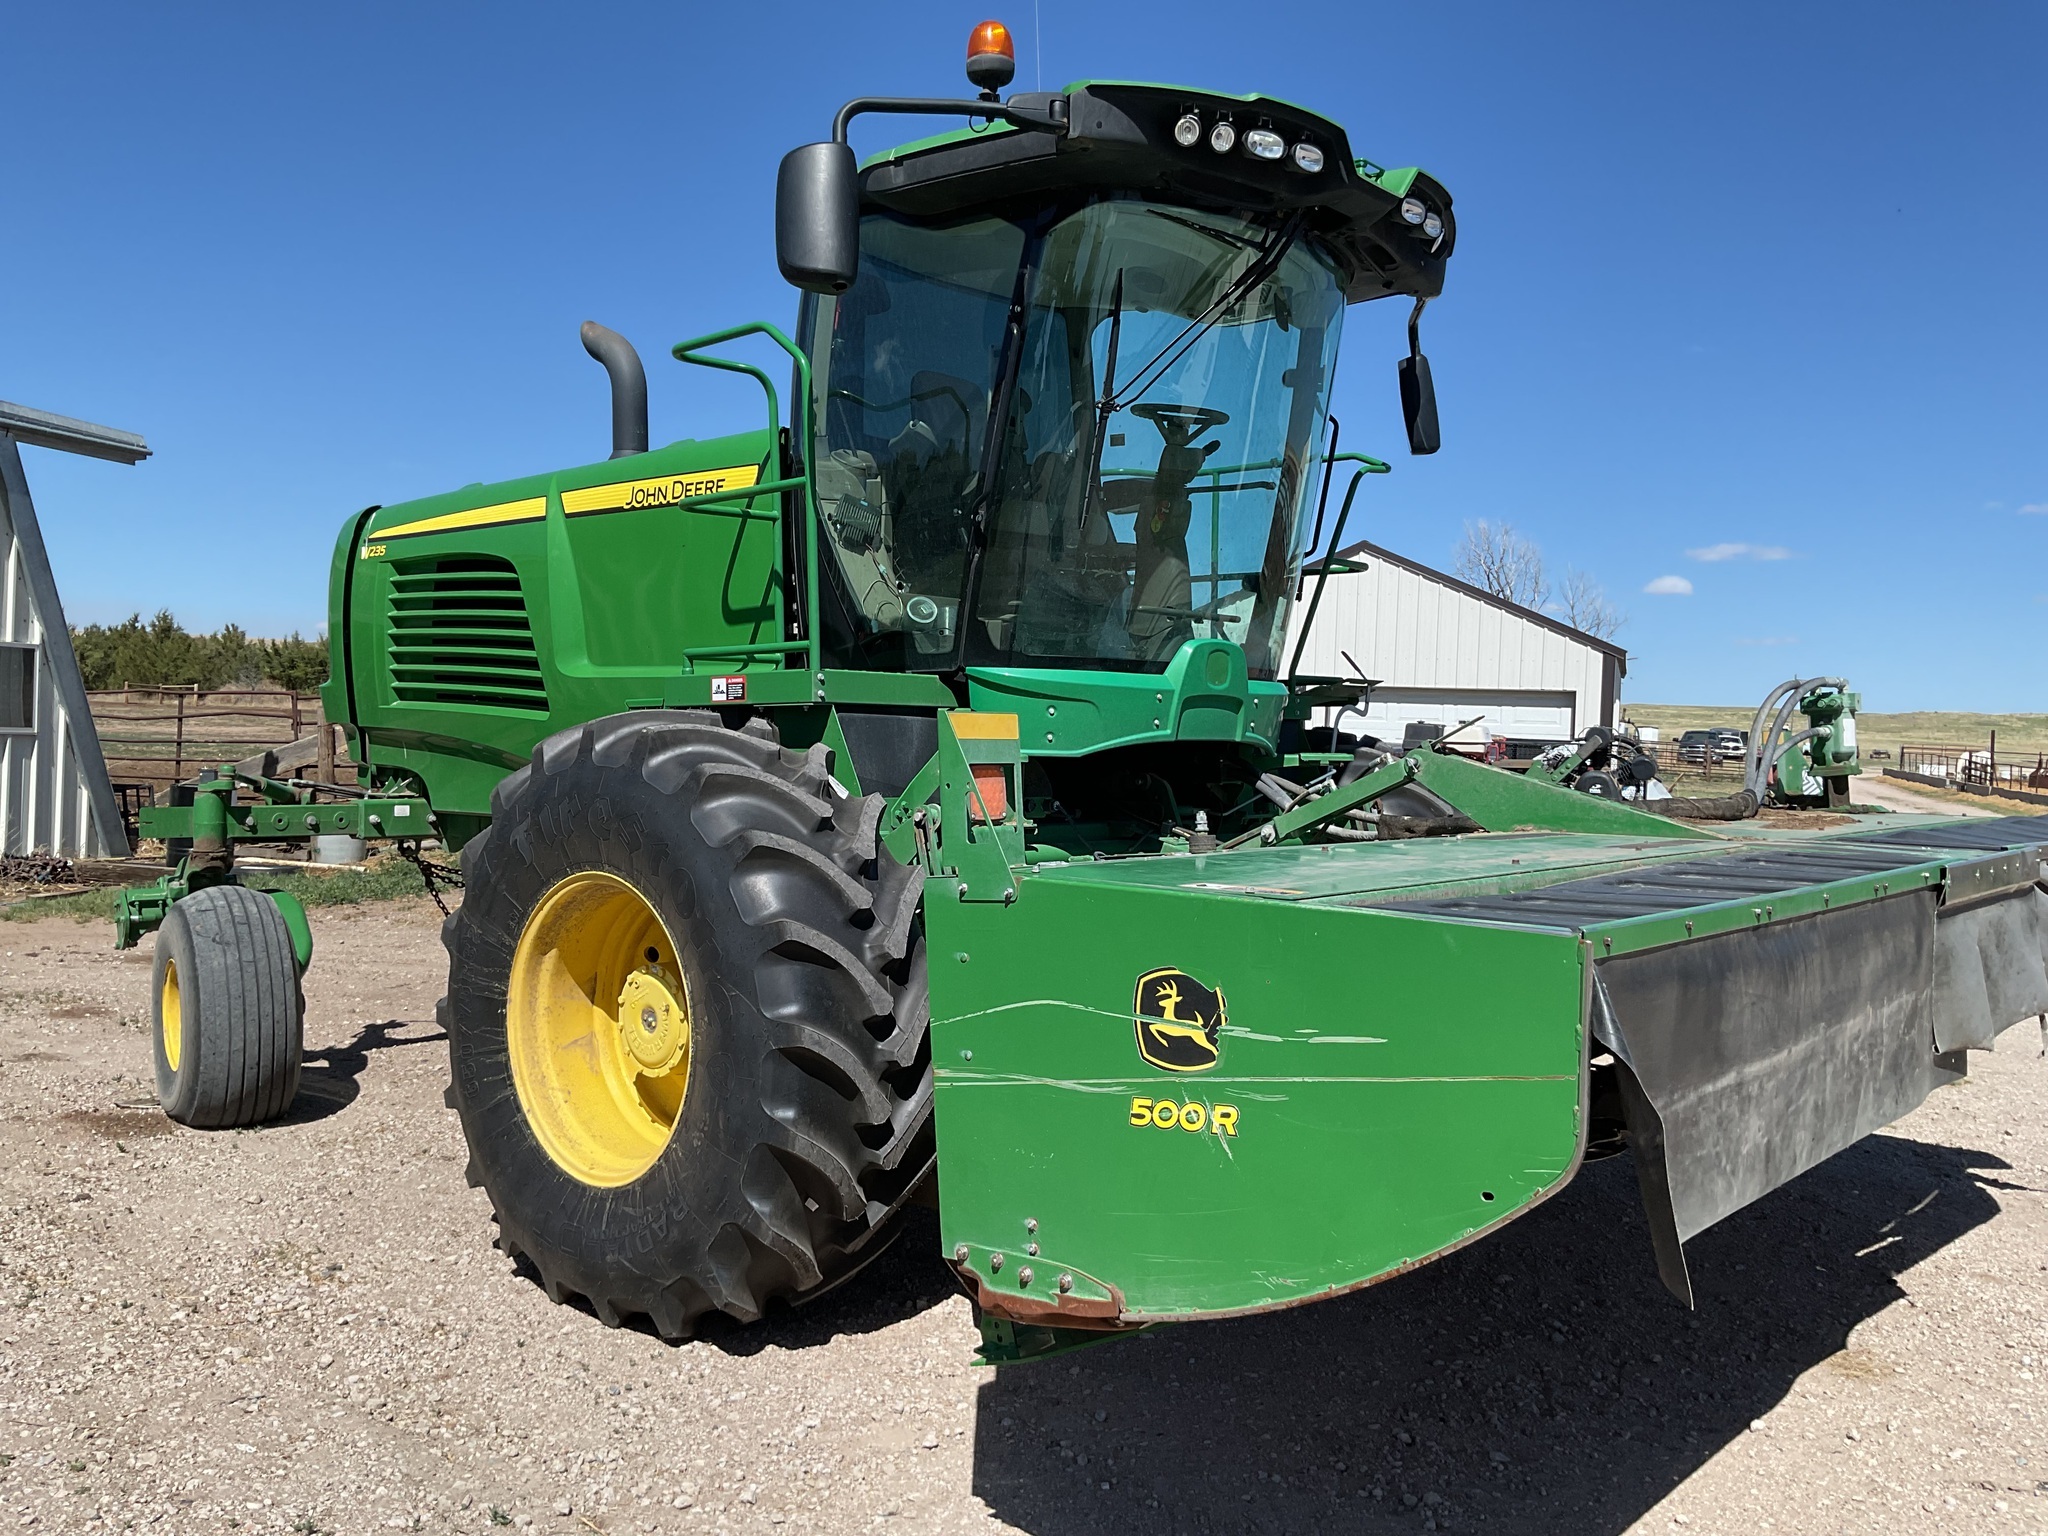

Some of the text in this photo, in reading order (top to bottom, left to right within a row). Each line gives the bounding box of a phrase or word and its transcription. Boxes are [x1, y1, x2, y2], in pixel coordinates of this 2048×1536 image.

[625, 478, 726, 506] JOHN DEERE
[360, 544, 387, 560] W235
[1129, 1095, 1240, 1138] 500R
